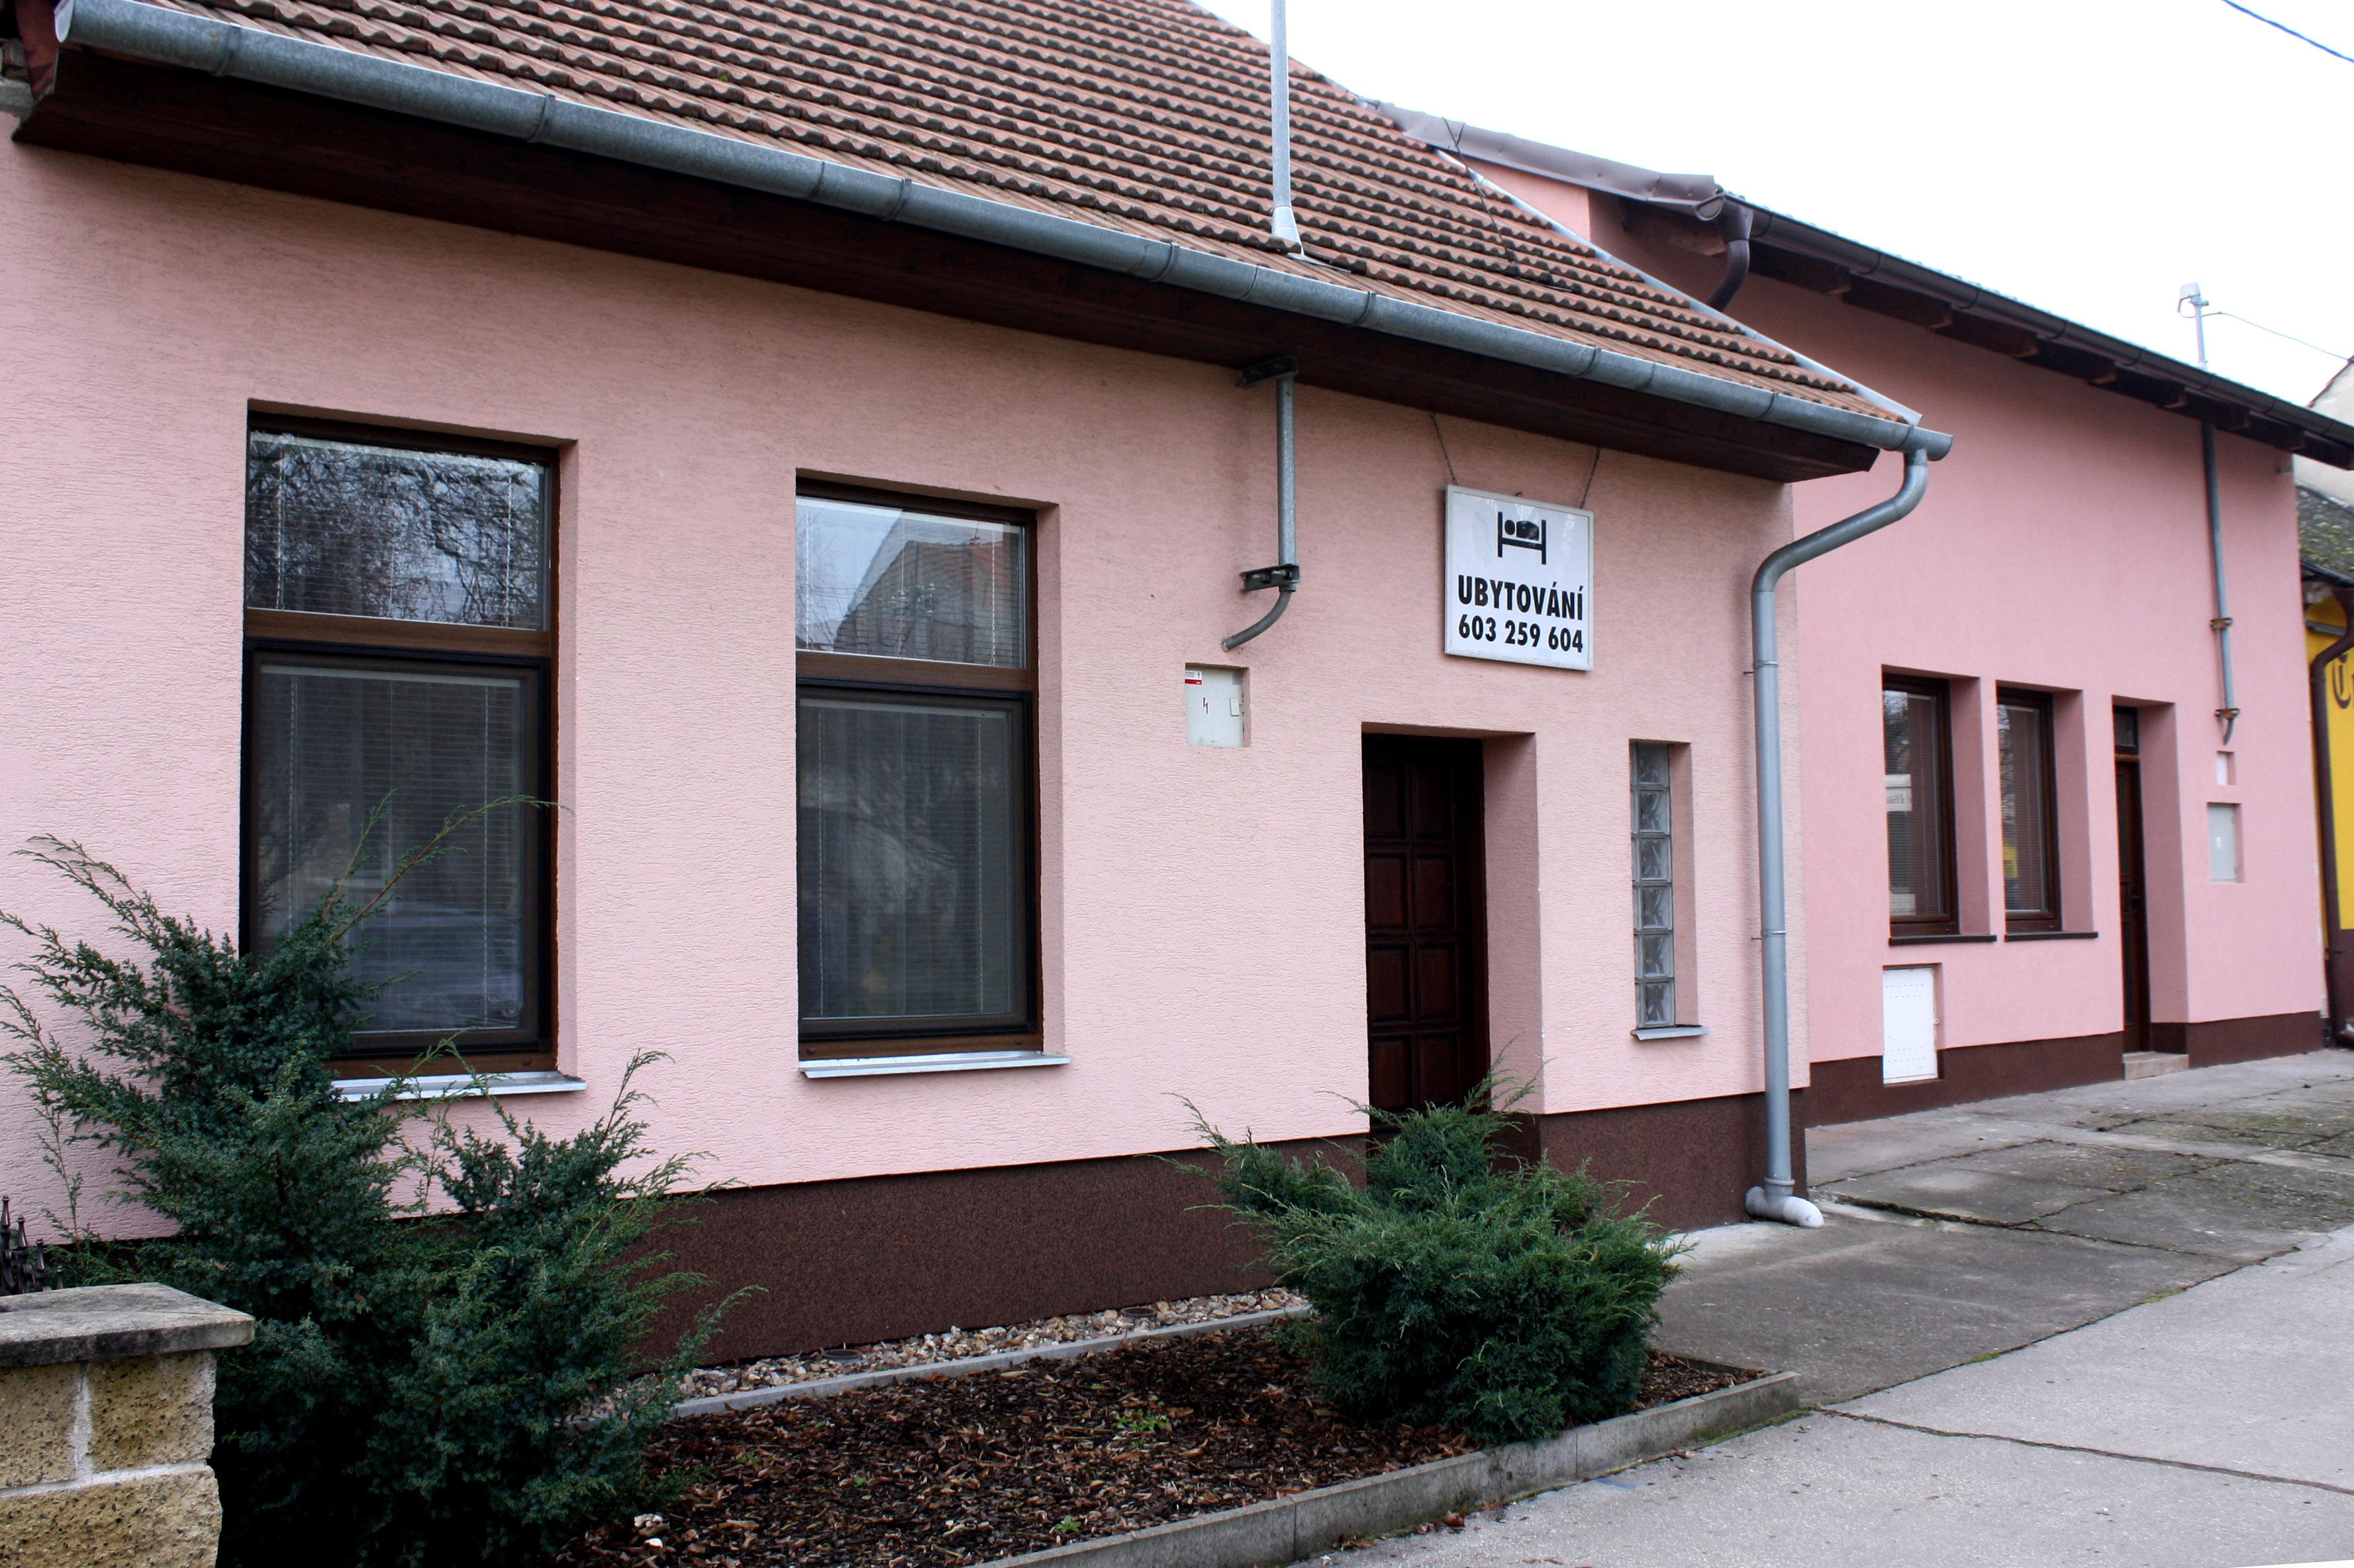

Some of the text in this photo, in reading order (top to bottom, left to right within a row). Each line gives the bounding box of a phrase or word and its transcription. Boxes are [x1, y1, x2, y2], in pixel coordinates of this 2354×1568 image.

[1458, 574, 1584, 620] UBYTOVÁNÍ
[1458, 614, 1583, 653] 603 259 604
